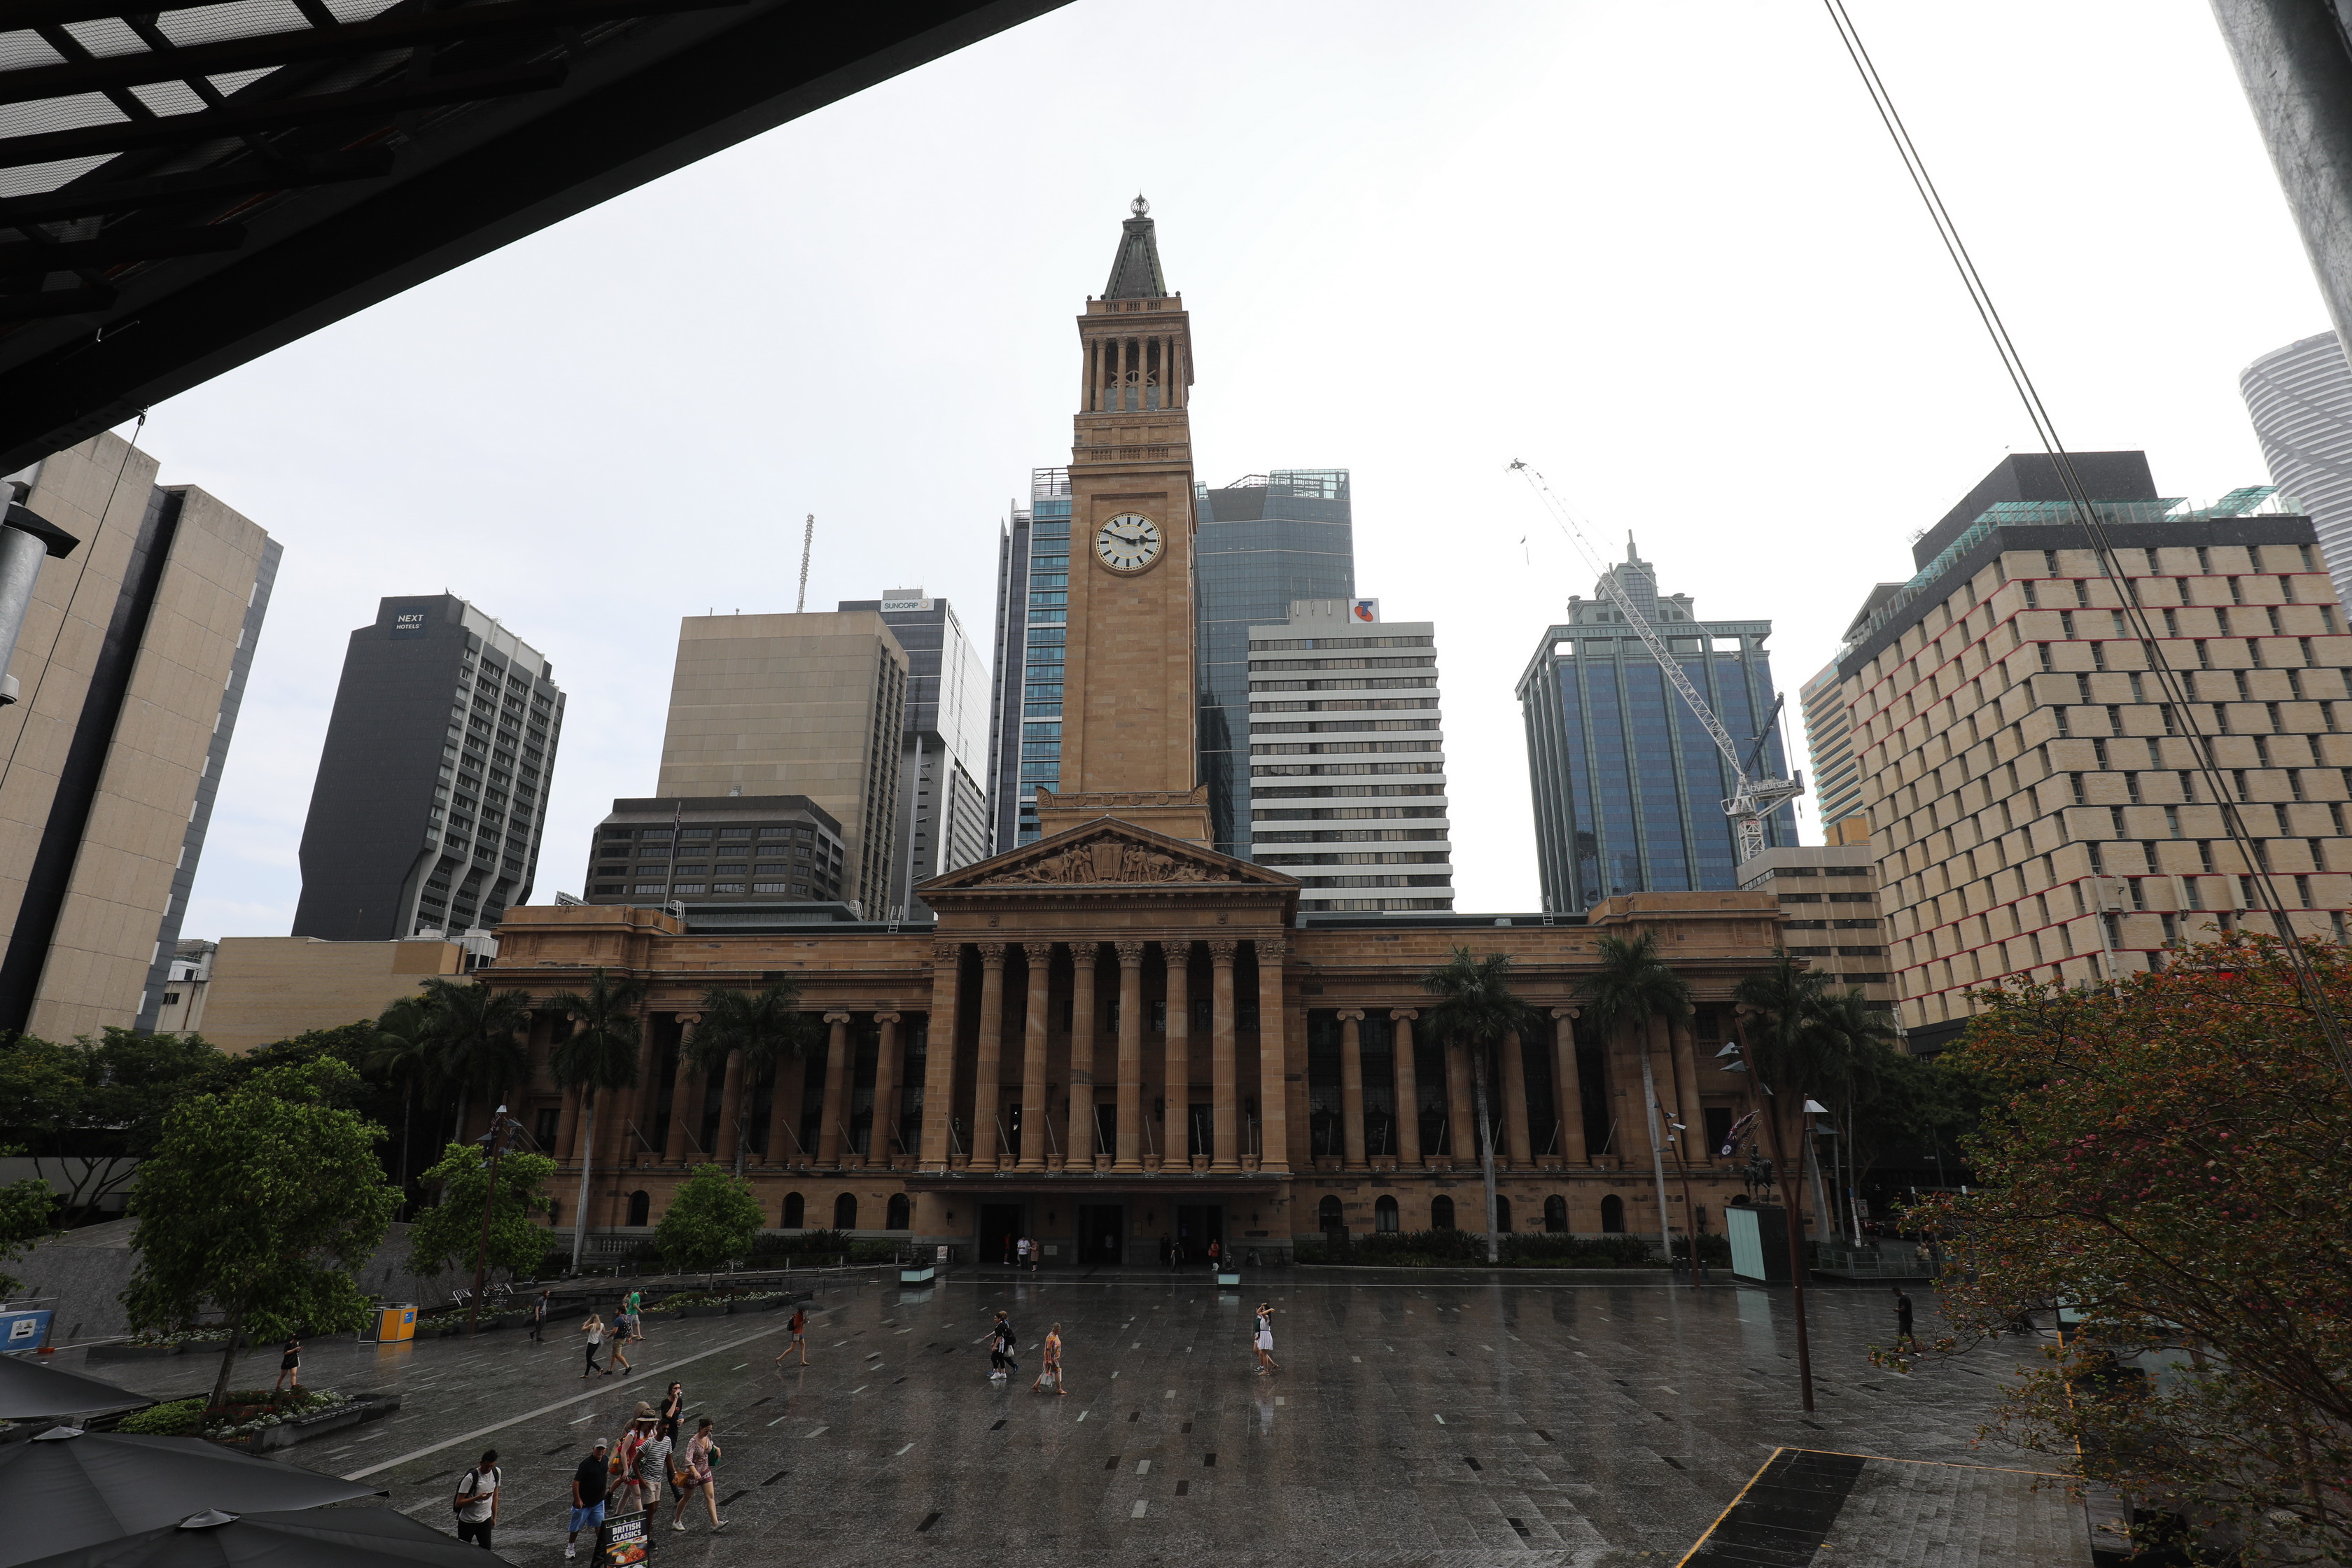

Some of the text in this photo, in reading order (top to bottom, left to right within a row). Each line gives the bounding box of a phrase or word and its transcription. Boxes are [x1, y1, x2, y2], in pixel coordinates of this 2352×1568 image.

[398, 614, 424, 622] NEXT
[612, 1521, 641, 1535] BRITISH
[612, 1530, 642, 1542] CLASSICS
